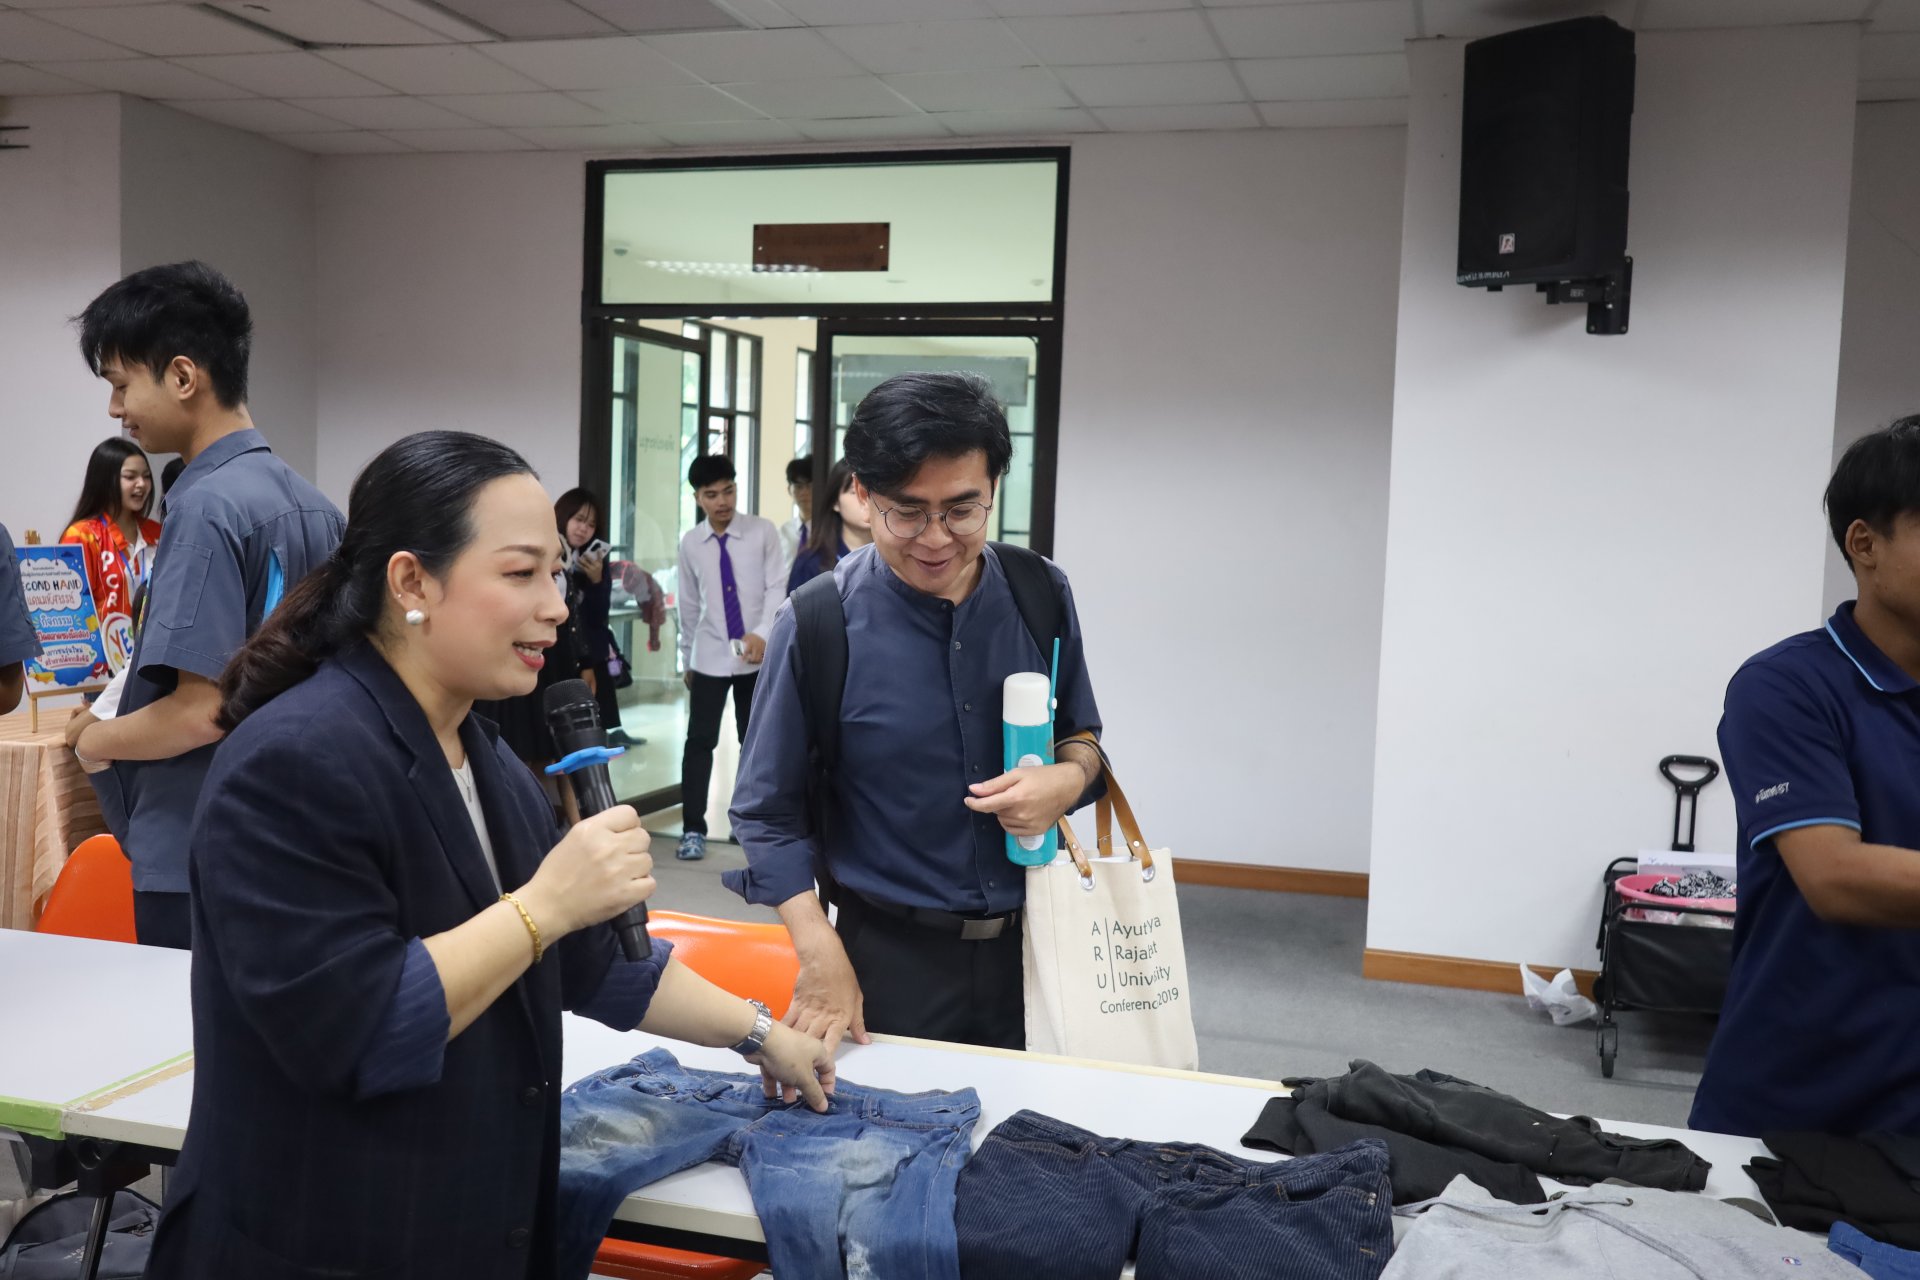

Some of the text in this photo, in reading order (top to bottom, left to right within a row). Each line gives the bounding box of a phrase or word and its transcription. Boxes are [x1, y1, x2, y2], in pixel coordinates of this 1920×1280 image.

[53, 579, 82, 591] HAND
[1091, 920, 1101, 936] A
[1093, 946, 1103, 961] R
[1096, 973, 1107, 989] U
[1100, 999, 1158, 1014] Conferenc
